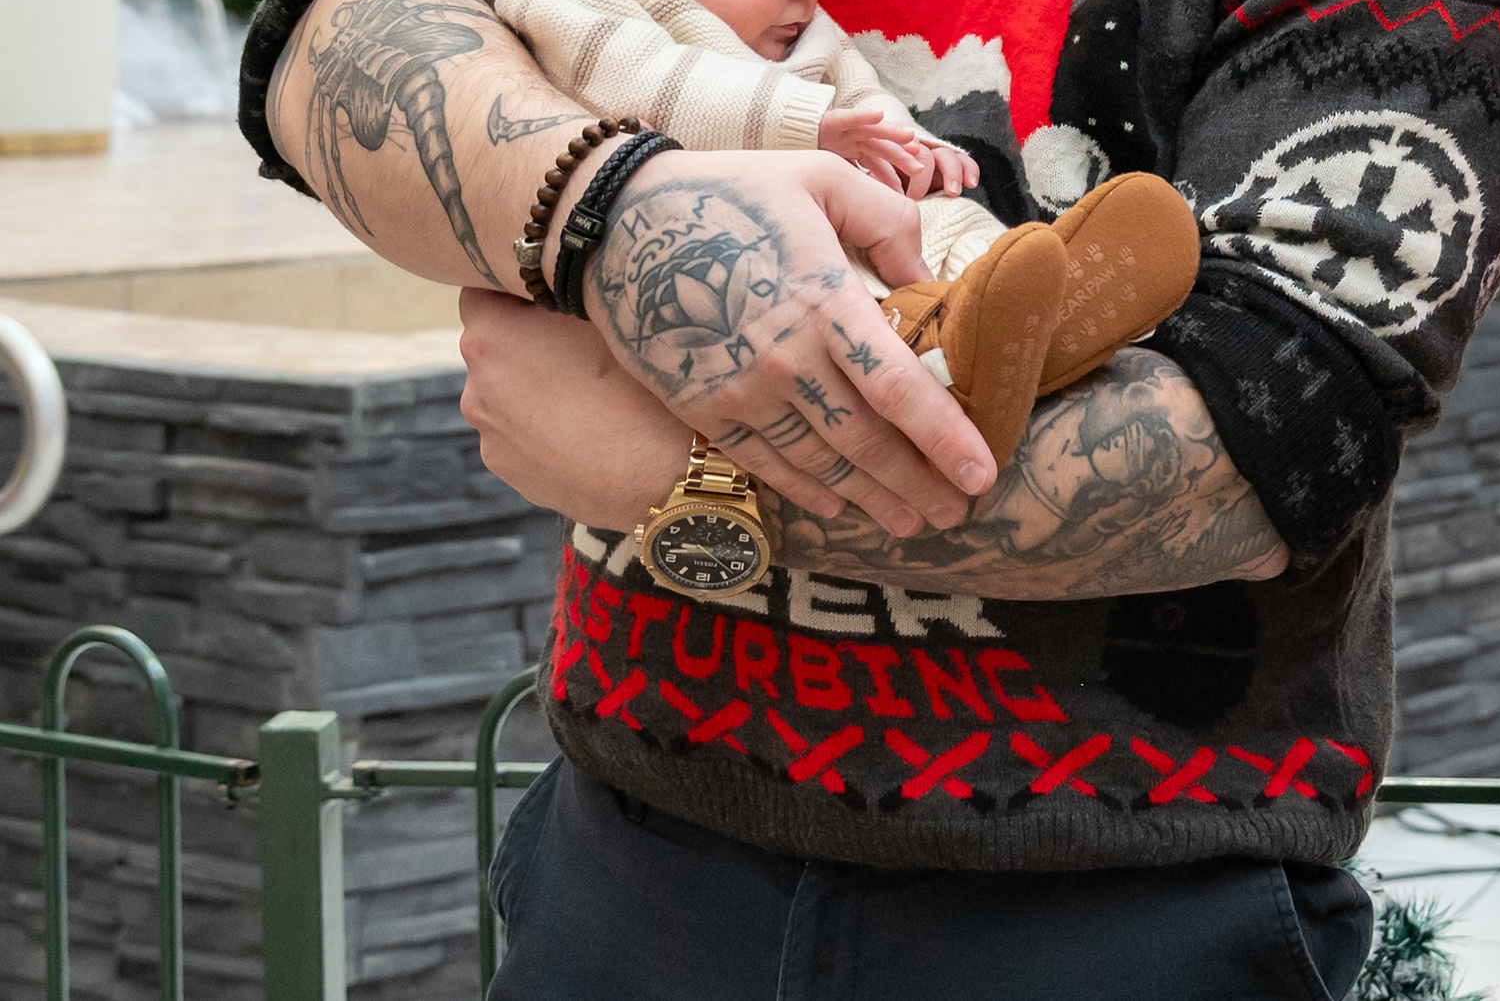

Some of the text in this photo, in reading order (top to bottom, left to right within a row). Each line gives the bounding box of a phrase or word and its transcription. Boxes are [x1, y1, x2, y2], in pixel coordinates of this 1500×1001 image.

[1058, 262, 1117, 323] EARPAW
[669, 525, 681, 534] 4
[739, 533, 750, 543] 8
[665, 553, 677, 563] 2
[693, 560, 718, 568] FOSSIL
[730, 561, 745, 571] 10
[695, 572, 711, 582] 12
